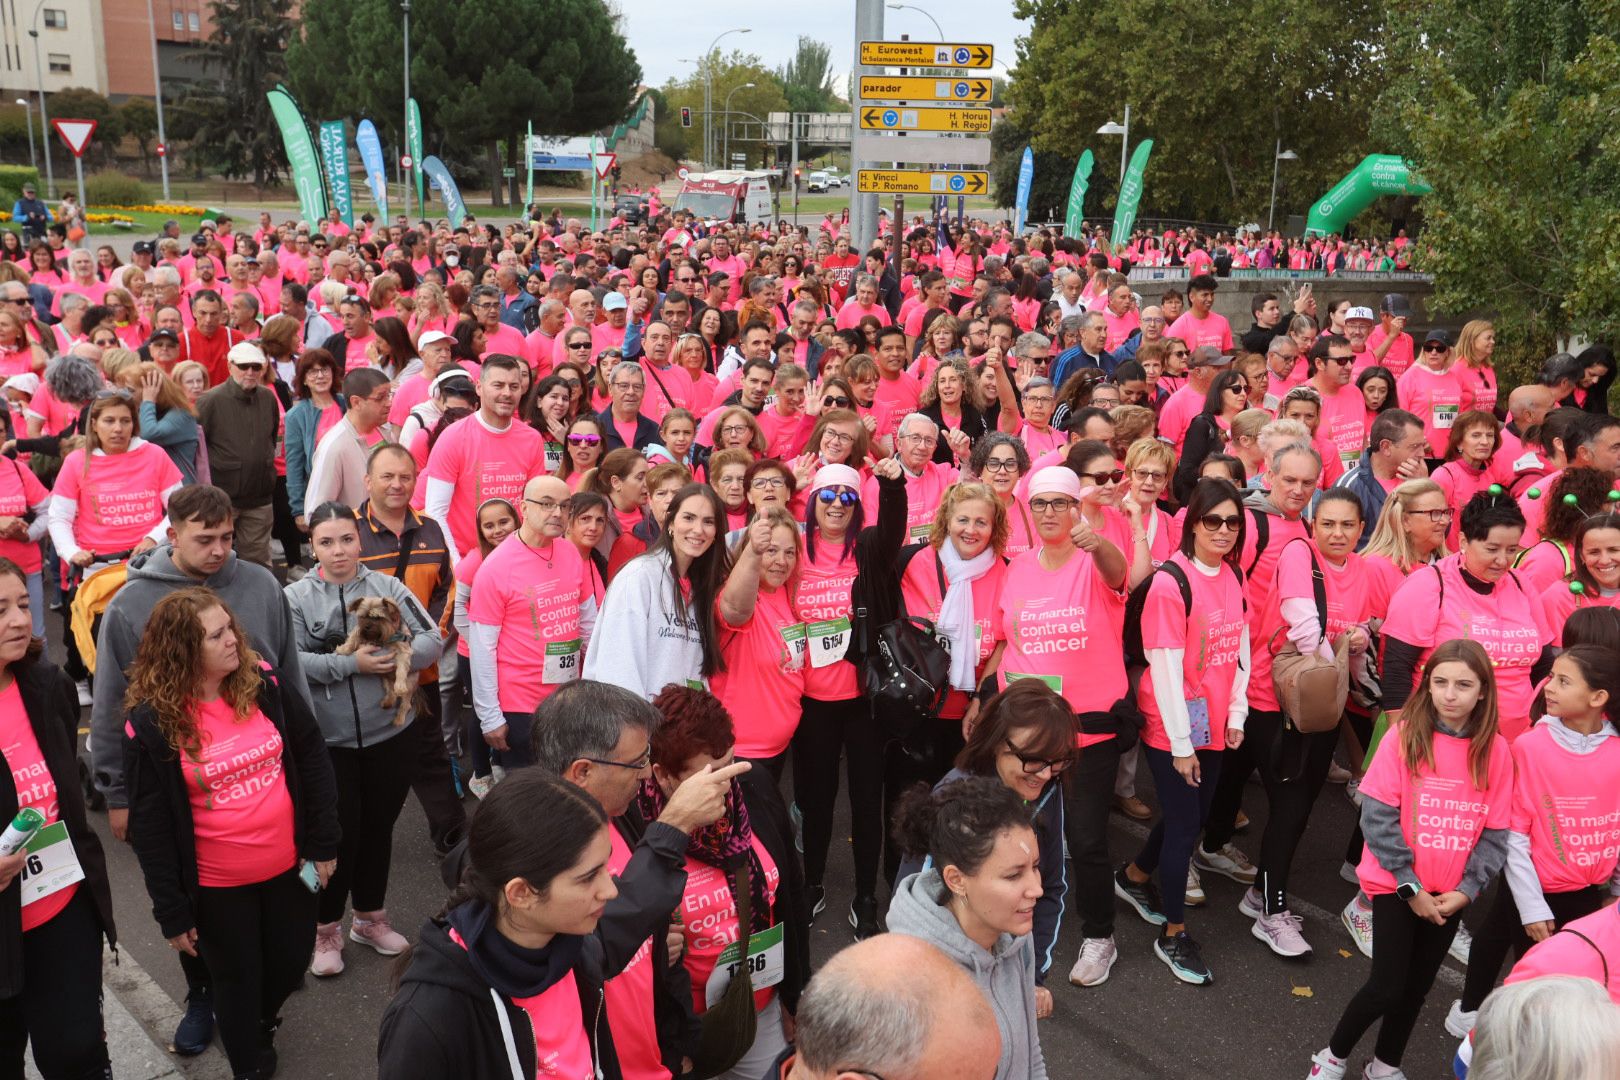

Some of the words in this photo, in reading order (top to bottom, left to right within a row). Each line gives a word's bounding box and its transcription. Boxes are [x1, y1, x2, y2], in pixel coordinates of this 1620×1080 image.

[878, 46, 923, 55] Eurowest
[863, 84, 902, 93] parador
[962, 112, 988, 120] Horus
[963, 121, 988, 130] Regio
[1371, 172, 1396, 180] contra
[860, 182, 869, 190] H.
[482, 474, 494, 483] En
[98, 493, 114, 503] En
[116, 489, 156, 502] marcha
[482, 484, 517, 495] contra
[100, 503, 144, 514] contra
[146, 501, 155, 510] el
[800, 581, 814, 591] En
[537, 598, 551, 608] En
[797, 591, 848, 605] contra
[540, 605, 577, 623] contra
[1021, 610, 1035, 621] En
[1039, 605, 1085, 620] marcha
[1020, 622, 1068, 637] contra
[1070, 619, 1086, 632] el
[1472, 624, 1489, 635] En
[1491, 627, 1537, 638] marcha
[822, 633, 843, 650] 6154
[982, 632, 995, 644] el
[1022, 635, 1088, 655] cáncer
[1526, 640, 1539, 652] el
[559, 655, 575, 668] 325
[204, 761, 229, 777] En
[210, 757, 276, 789] contra
[1419, 793, 1440, 808] En
[1418, 814, 1474, 831] contra
[1557, 814, 1576, 828] En
[684, 894, 711, 912] En
